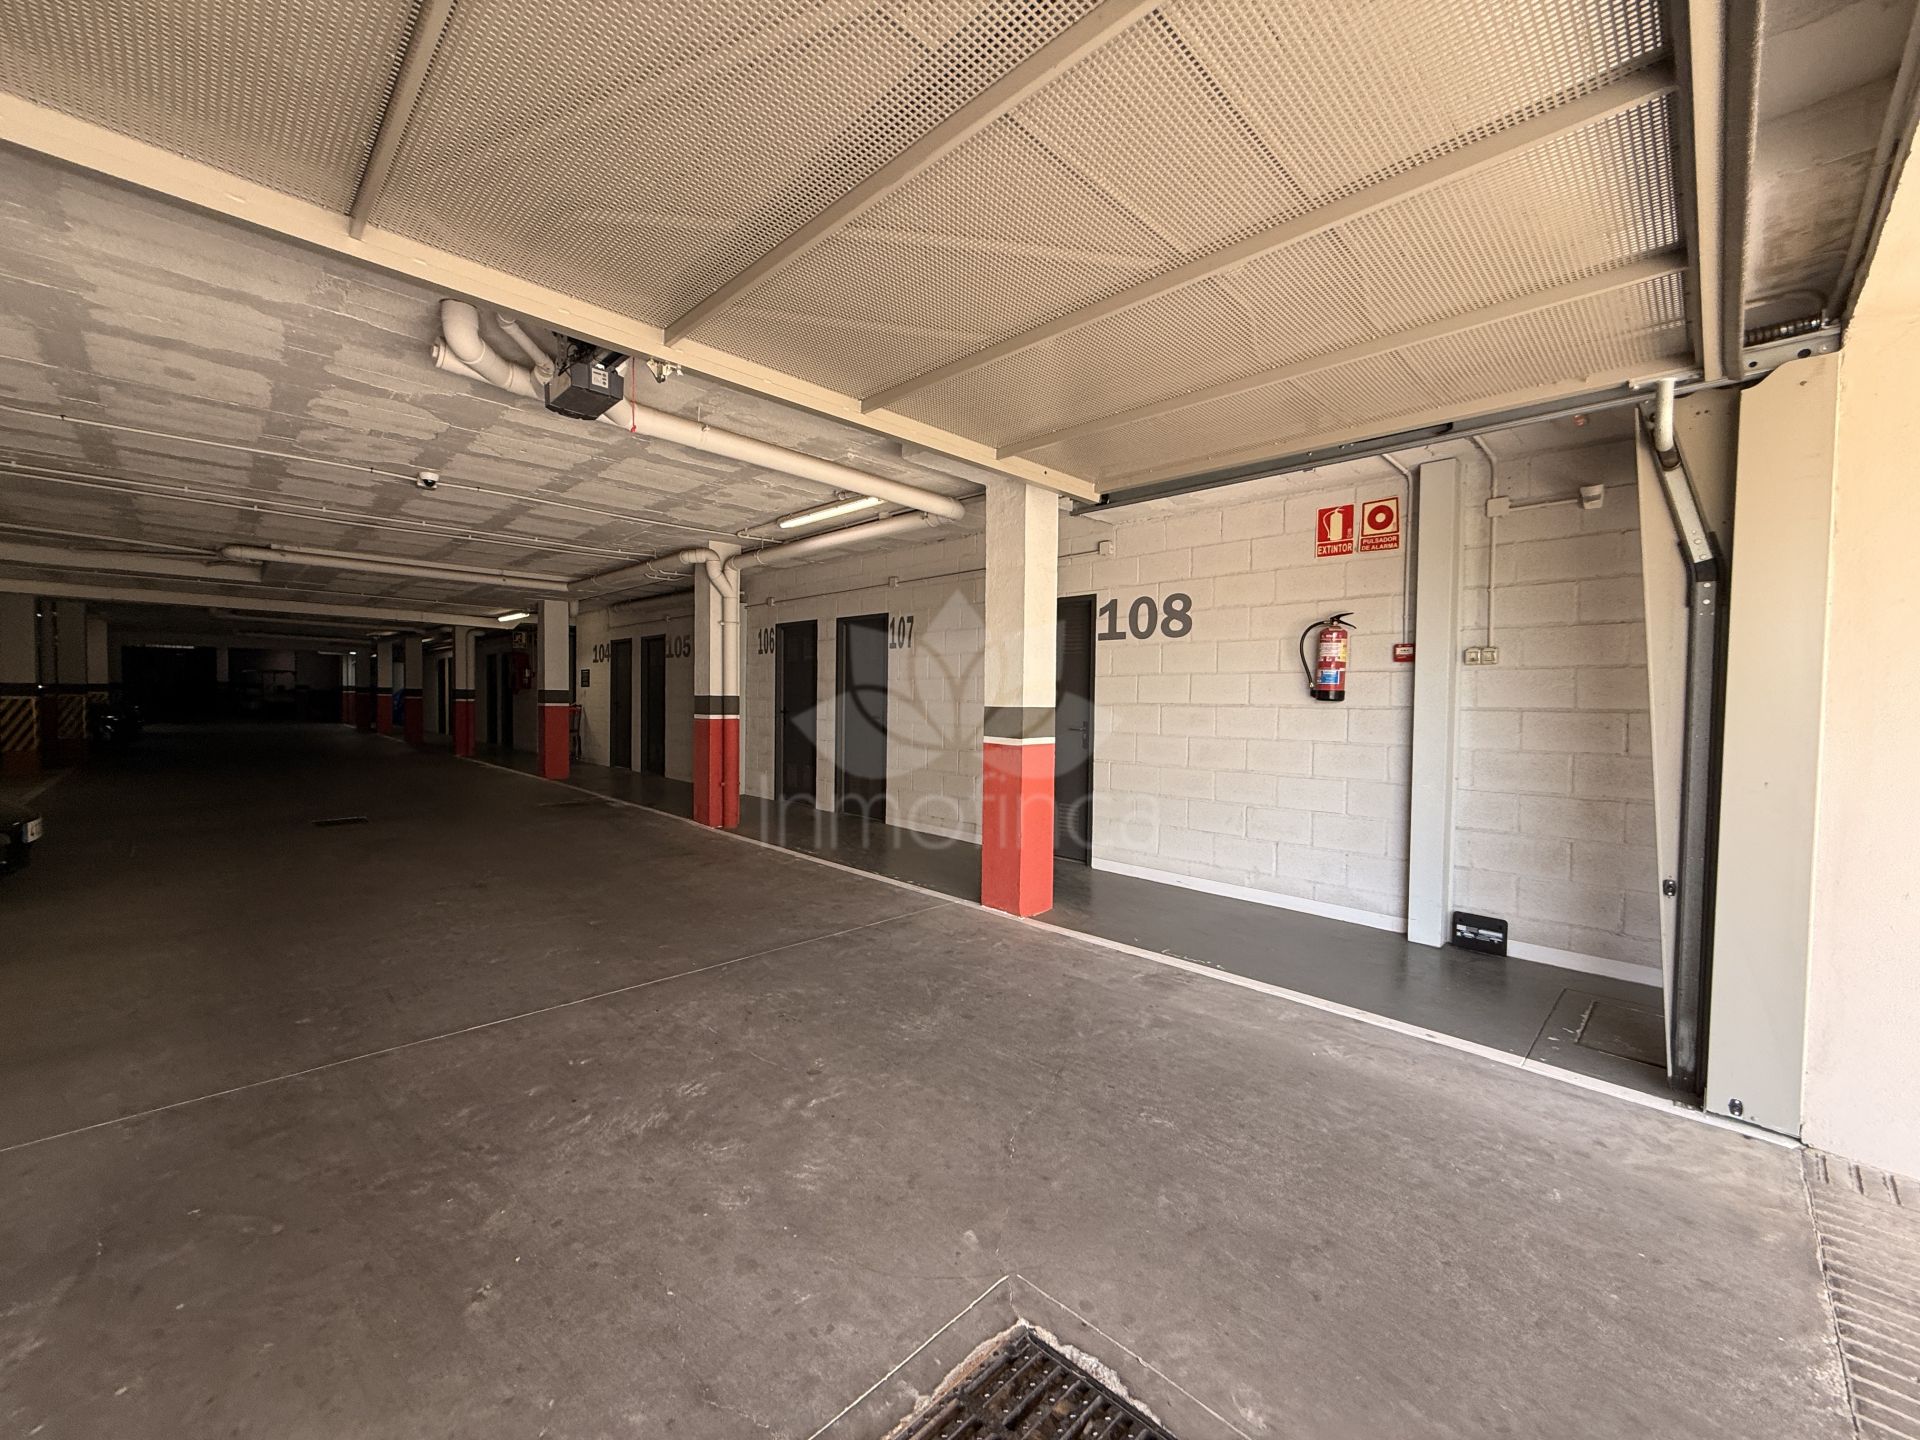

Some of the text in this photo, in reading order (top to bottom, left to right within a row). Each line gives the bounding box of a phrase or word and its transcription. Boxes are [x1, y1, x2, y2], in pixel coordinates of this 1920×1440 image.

[1317, 543, 1352, 555] EXTINTOR
[1362, 535, 1397, 545] PULSADOR
[1371, 542, 1398, 550] ALARMA
[1098, 592, 1192, 641] 108
[757, 627, 775, 655] 106
[889, 615, 914, 649] 107
[592, 643, 611, 663] 104
[665, 635, 691, 659] 105
